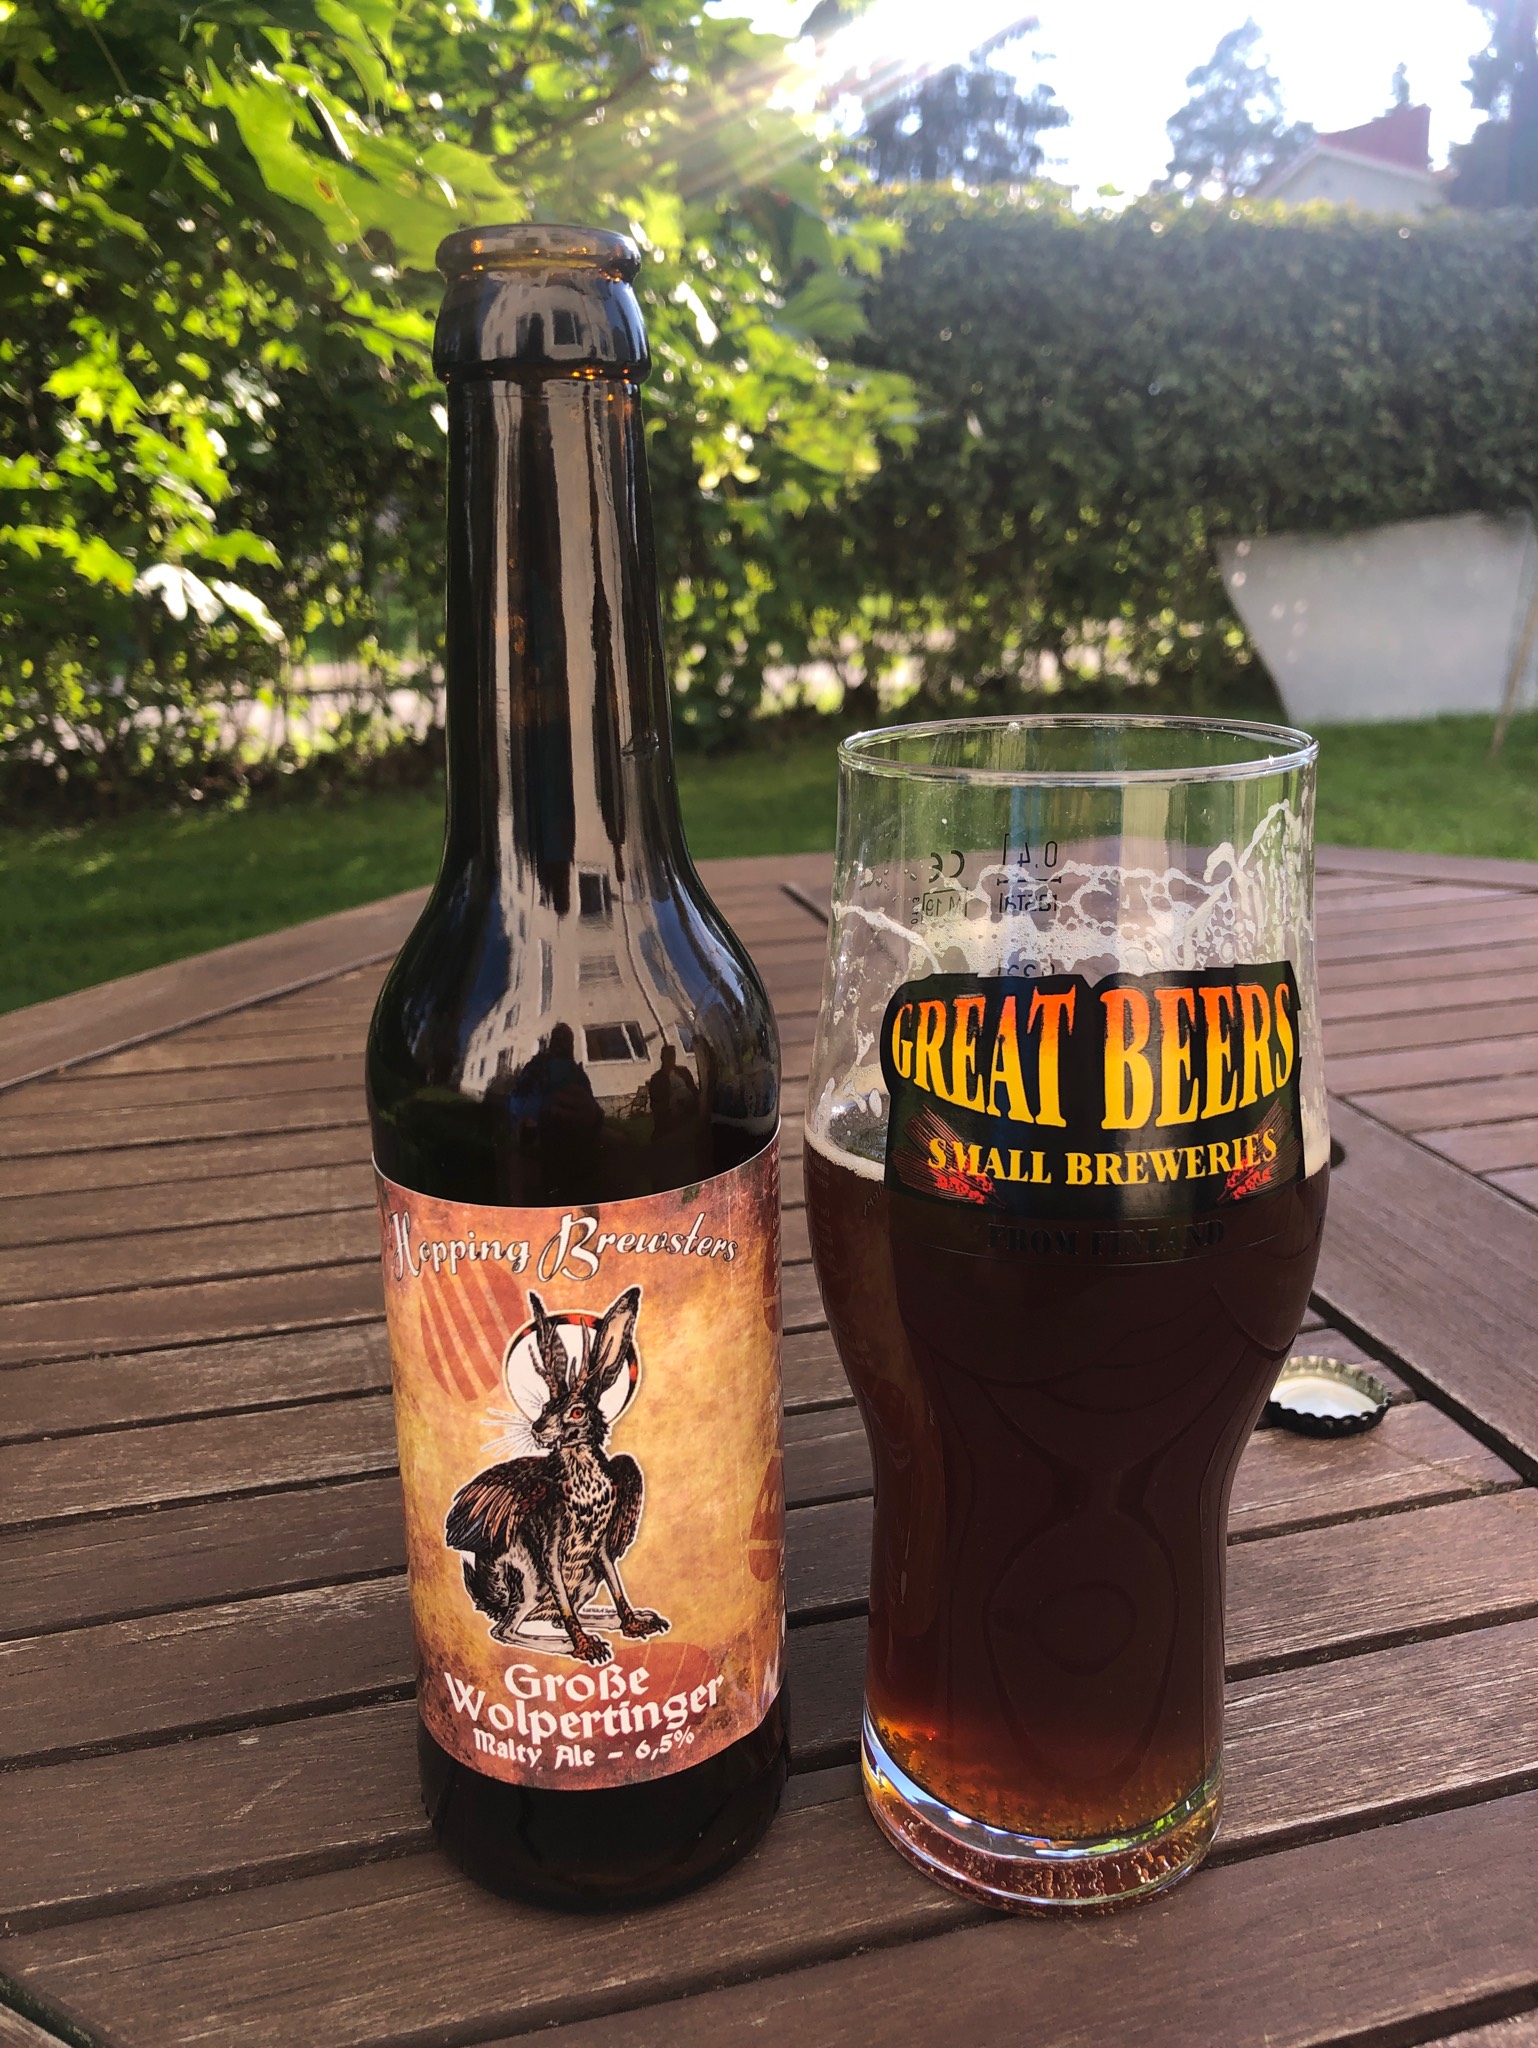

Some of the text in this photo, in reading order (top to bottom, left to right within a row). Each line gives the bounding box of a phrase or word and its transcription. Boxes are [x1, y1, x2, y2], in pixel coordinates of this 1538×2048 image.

[892, 983, 1294, 1130] GREAT BEERS
[927, 1128, 1278, 1186] SMALL BREWERIES
[389, 1210, 531, 1282] Hopping
[538, 1212, 737, 1282] Brewsters
[987, 1219, 1226, 1256] FROM FINLAND
[444, 1672, 724, 1745] Wolpertinger
[504, 1663, 650, 1702] Große
[473, 1727, 542, 1768] Malty
[554, 1744, 596, 1770] Ale
[635, 1725, 696, 1762] 6,5%
